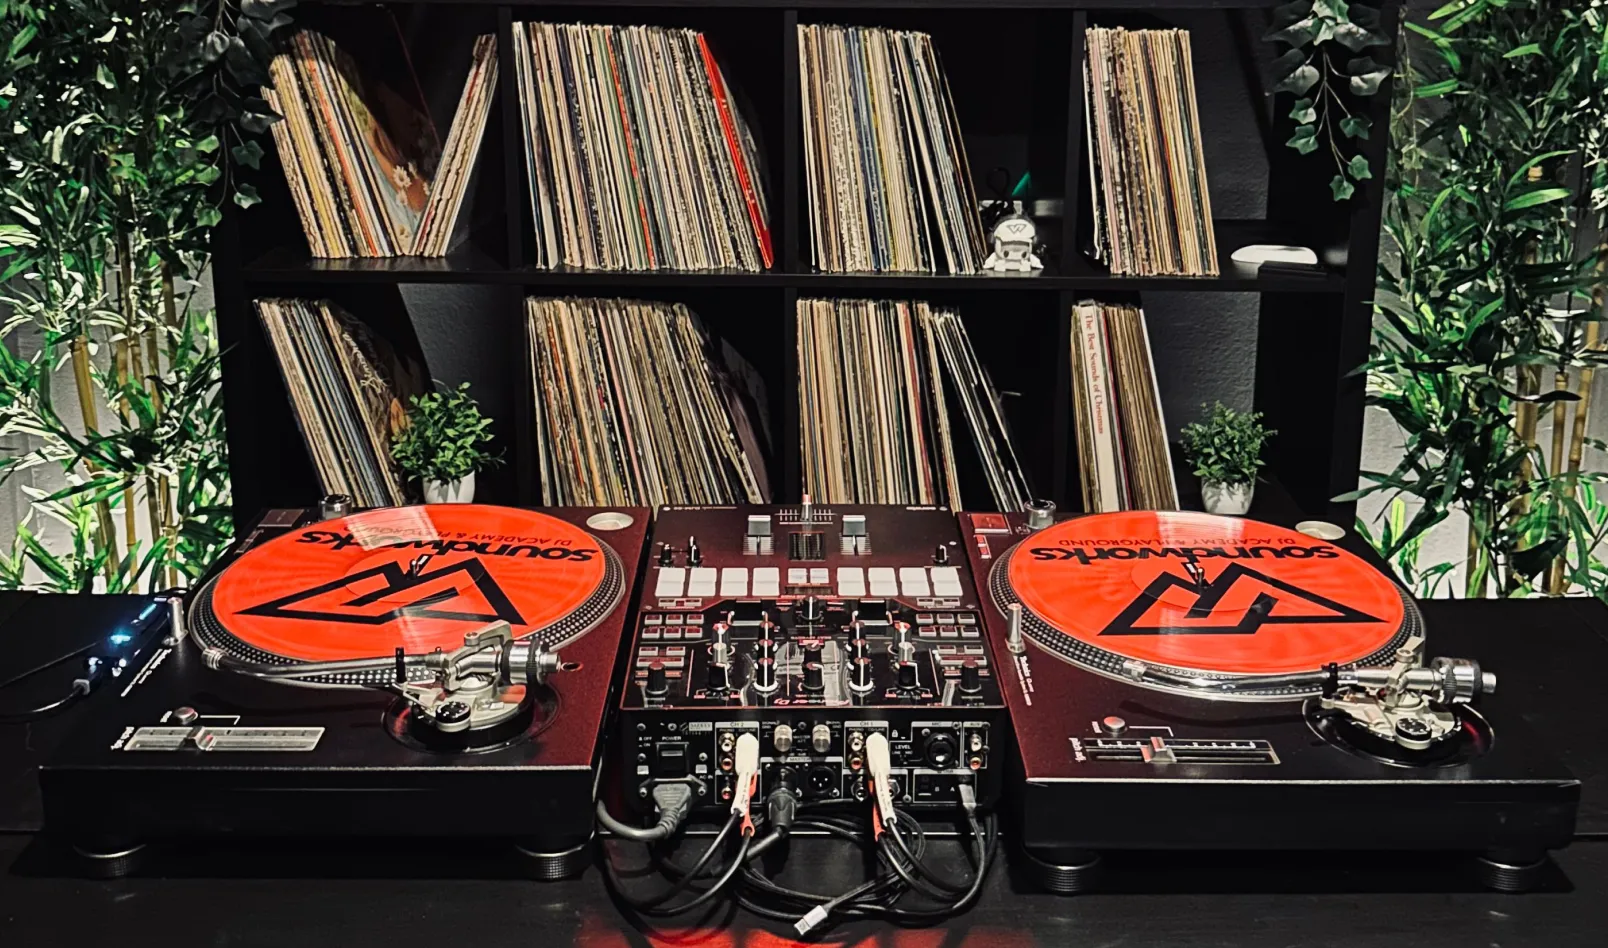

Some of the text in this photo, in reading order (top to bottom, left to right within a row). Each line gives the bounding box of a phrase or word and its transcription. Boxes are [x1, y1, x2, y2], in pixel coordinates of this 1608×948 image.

[1085, 314, 1104, 434] The Best Sounds of Christmas
[470, 532, 552, 545] ACADEMY
[1029, 545, 1341, 566] soundworks
